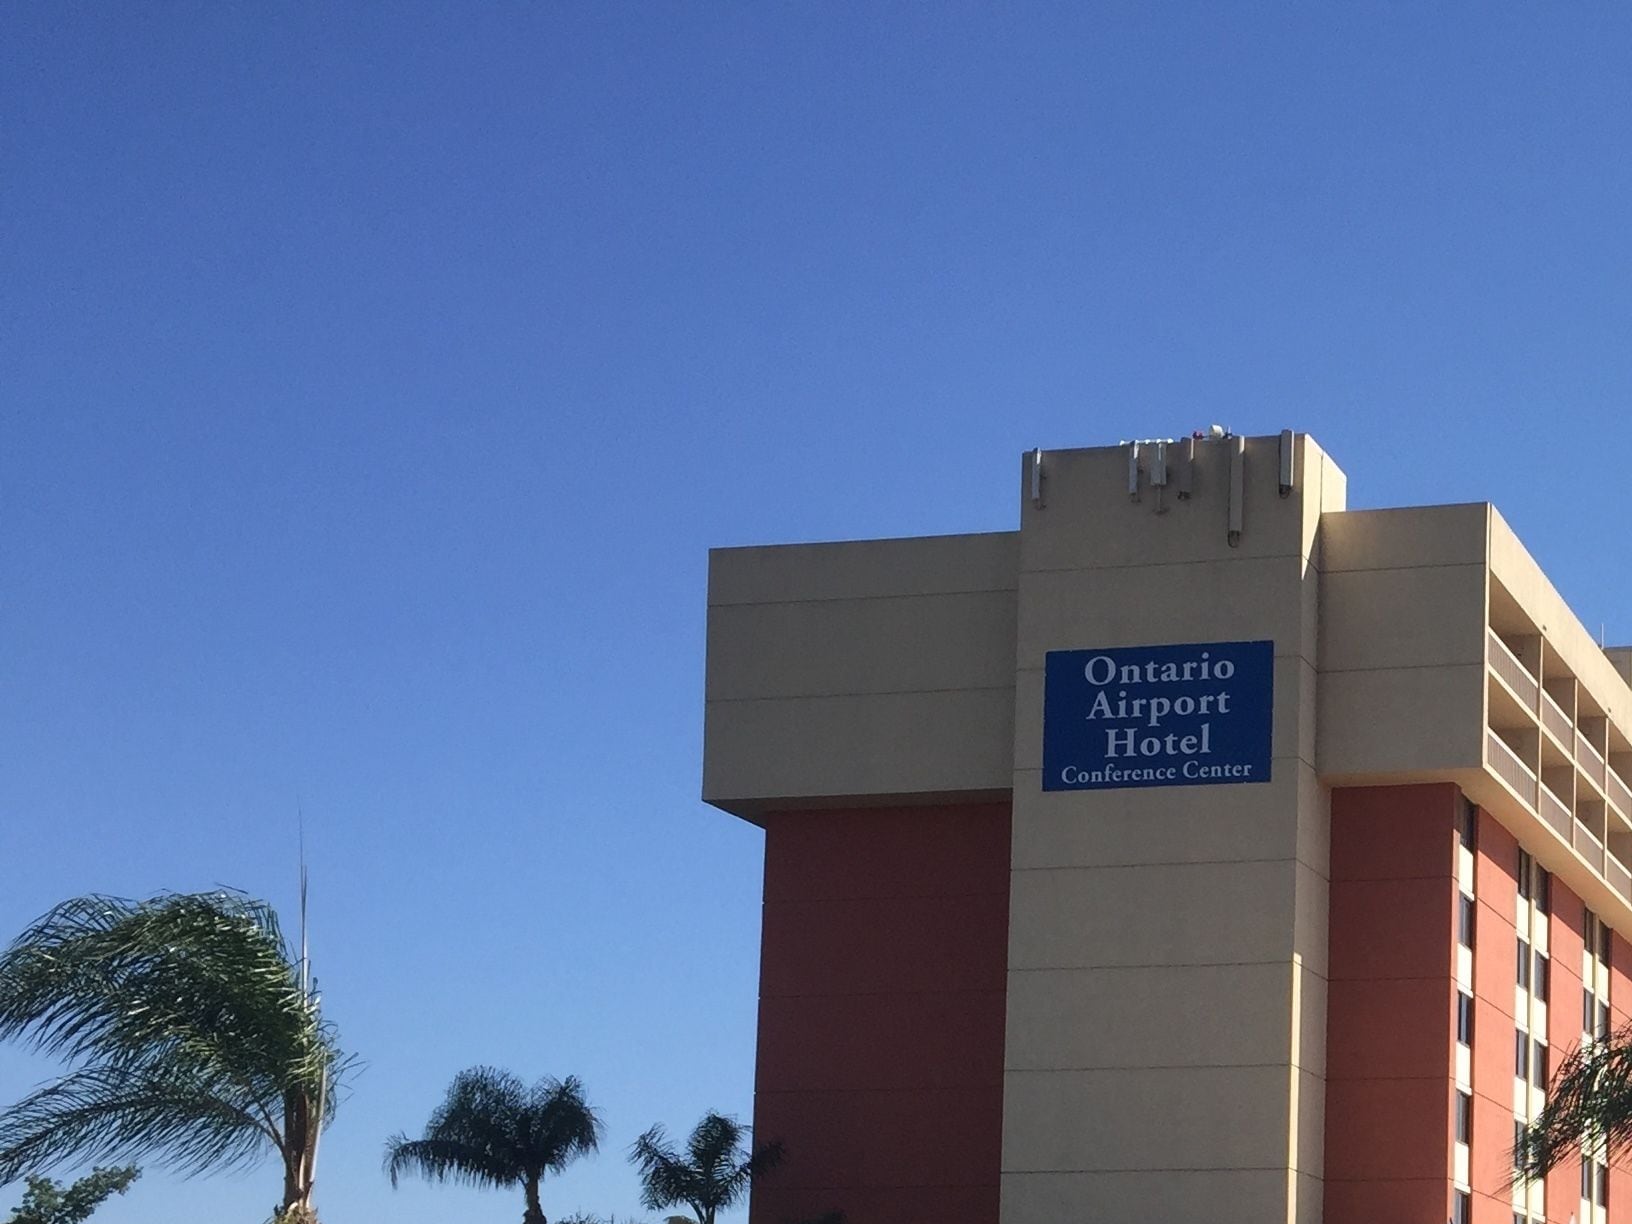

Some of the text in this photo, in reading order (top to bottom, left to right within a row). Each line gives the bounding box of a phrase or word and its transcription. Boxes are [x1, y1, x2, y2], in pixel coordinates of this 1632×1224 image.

[1084, 652, 1235, 686] Ontario
[1086, 690, 1231, 726] Airport
[1104, 724, 1212, 758] Hotel
[1061, 760, 1252, 784] Conference Center
